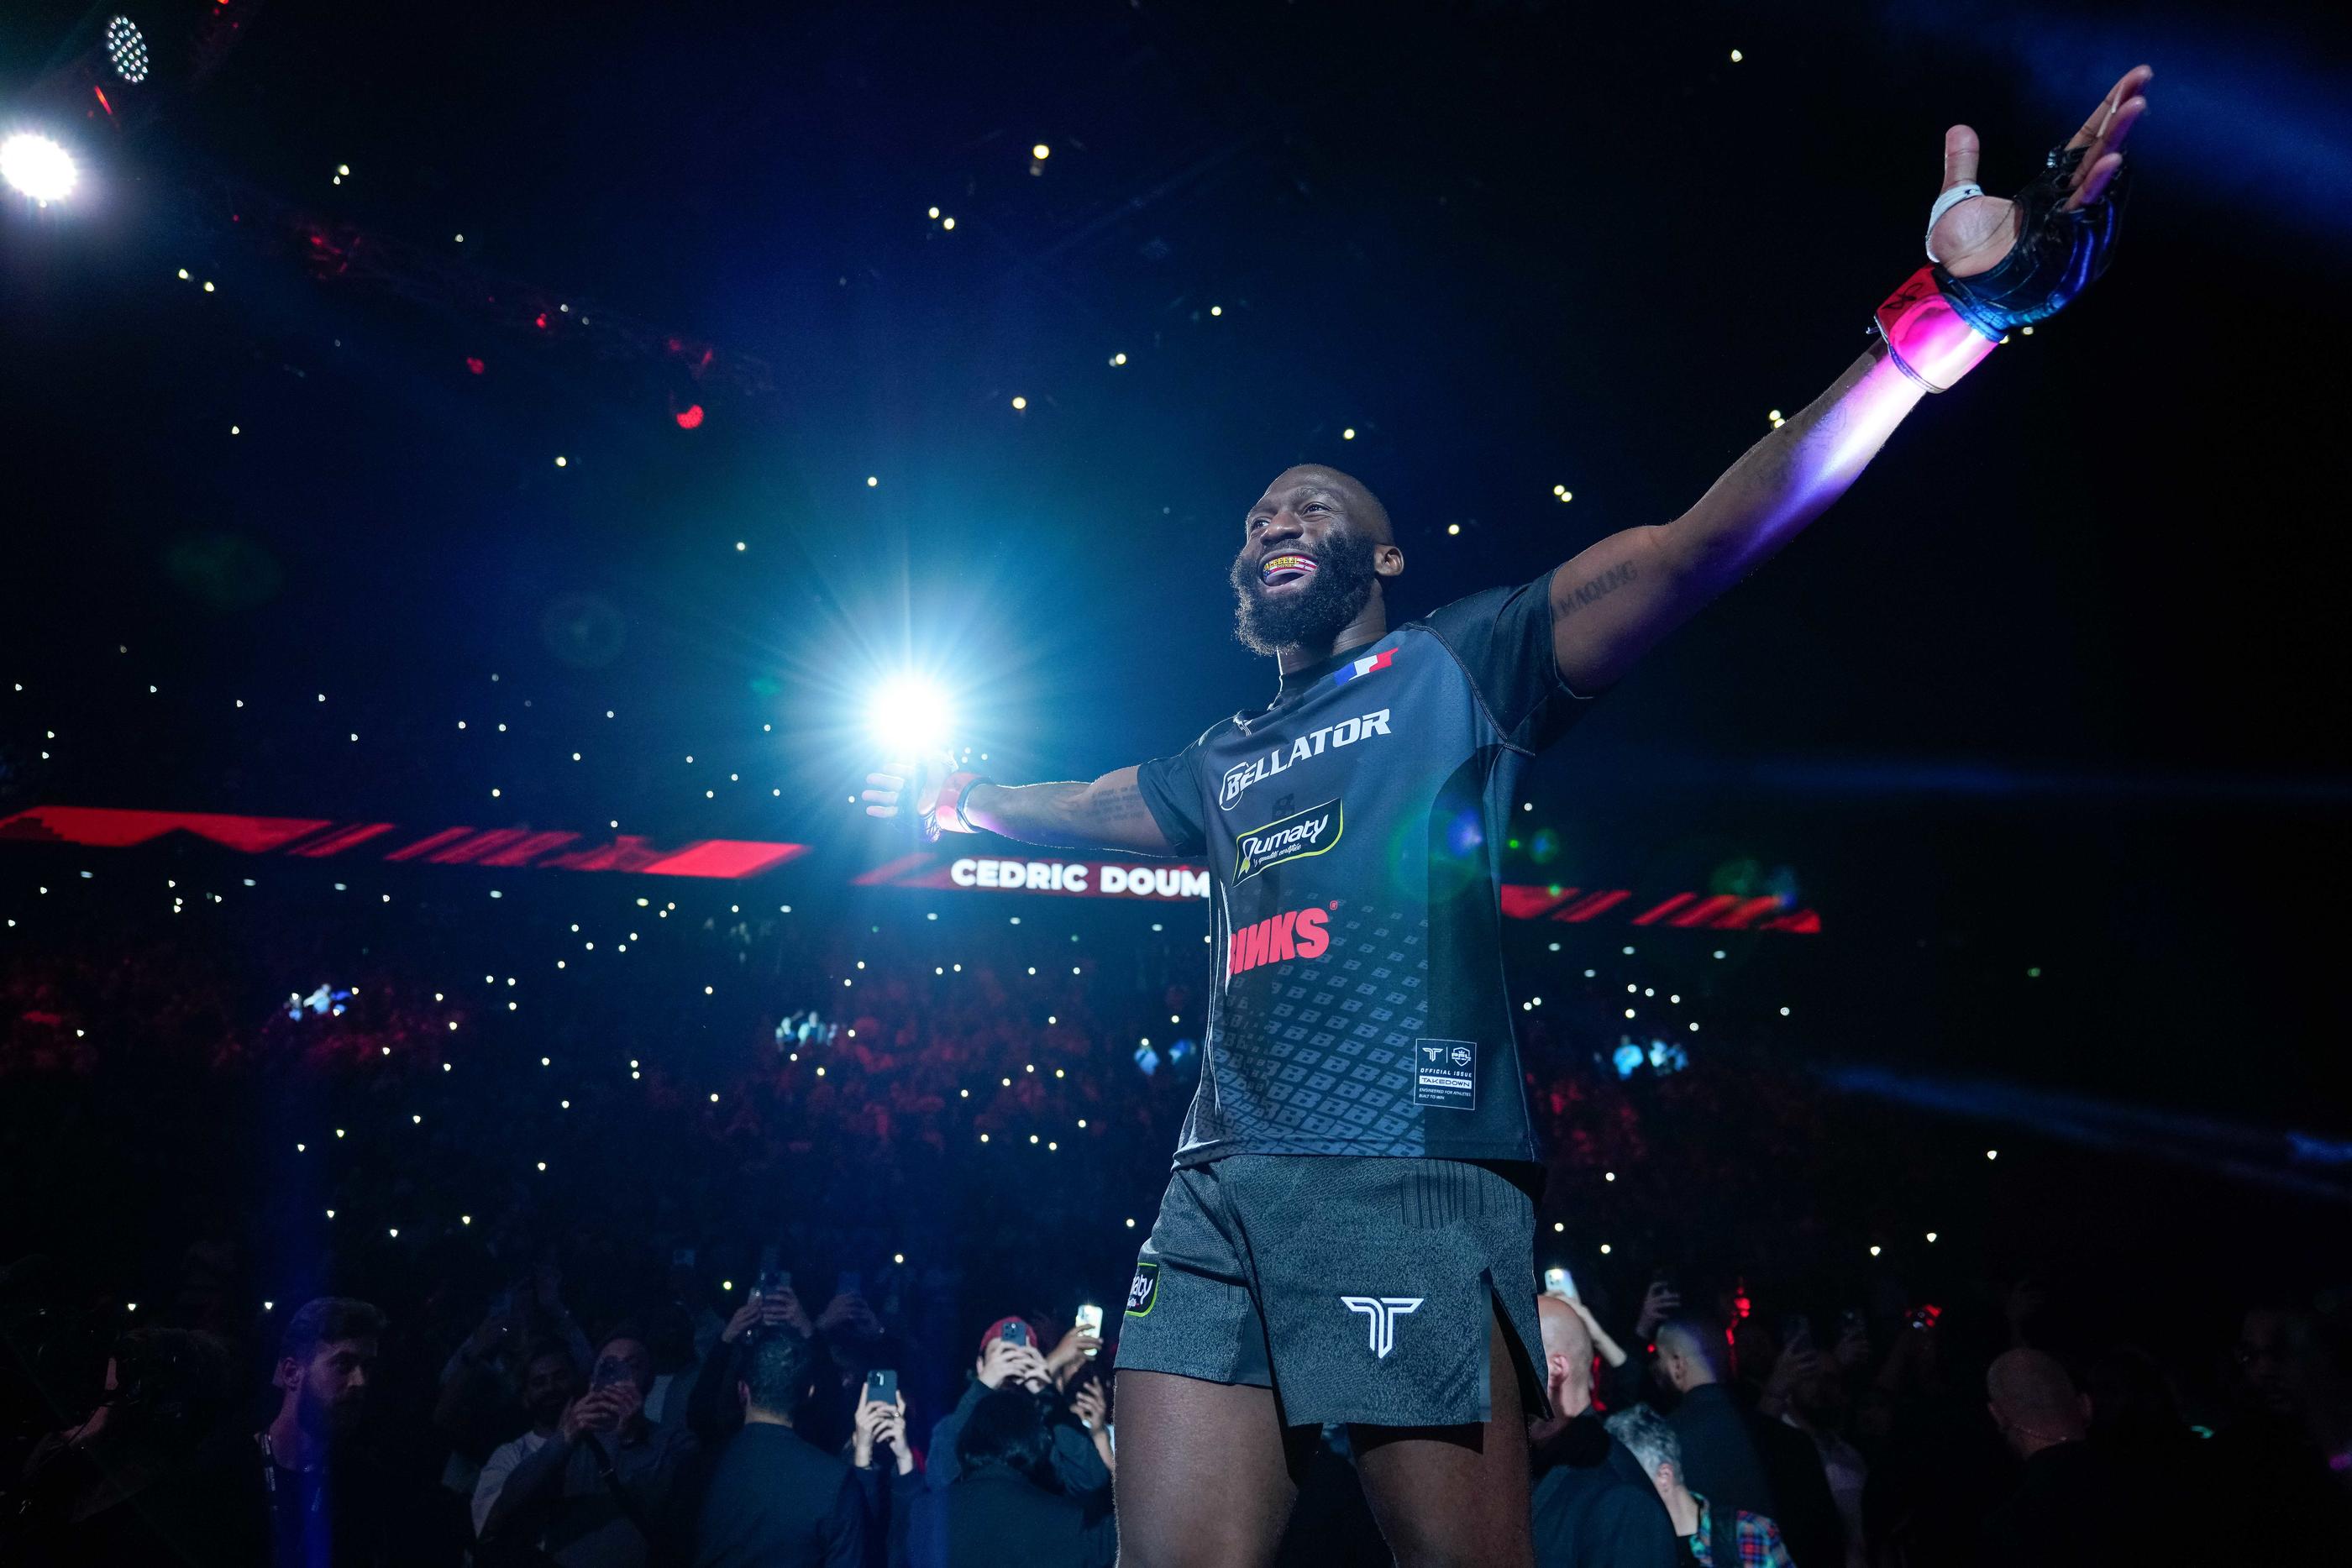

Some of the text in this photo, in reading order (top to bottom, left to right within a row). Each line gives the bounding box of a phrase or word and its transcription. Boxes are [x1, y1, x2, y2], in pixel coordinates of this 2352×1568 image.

[1223, 709, 1391, 803] BELLATOR
[950, 858, 1089, 893] CEDRIC
[1420, 1067, 1452, 1076] OFFICIAL
[1421, 1078, 1470, 1087] TAKEDOWN
